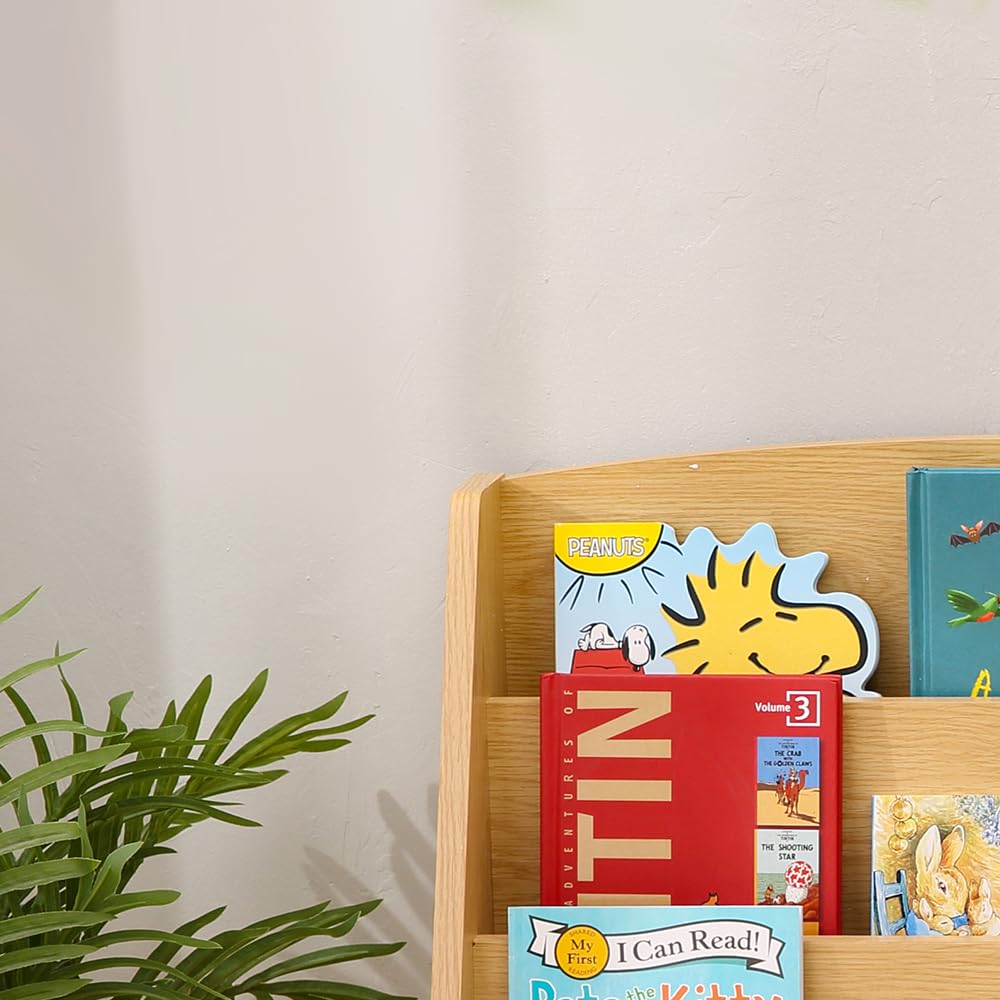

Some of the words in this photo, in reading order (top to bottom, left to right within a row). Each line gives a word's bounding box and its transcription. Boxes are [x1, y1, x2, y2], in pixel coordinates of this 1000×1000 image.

[567, 536, 645, 557] PEANUTS
[564, 690, 574, 715] OF
[755, 702, 791, 713] Volume
[794, 696, 810, 720] 3
[576, 690, 672, 906] TIN
[570, 939, 593, 953] My
[617, 943, 625, 962] I
[631, 940, 683, 961] Can
[690, 931, 760, 955] Read!
[567, 952, 598, 965] First
